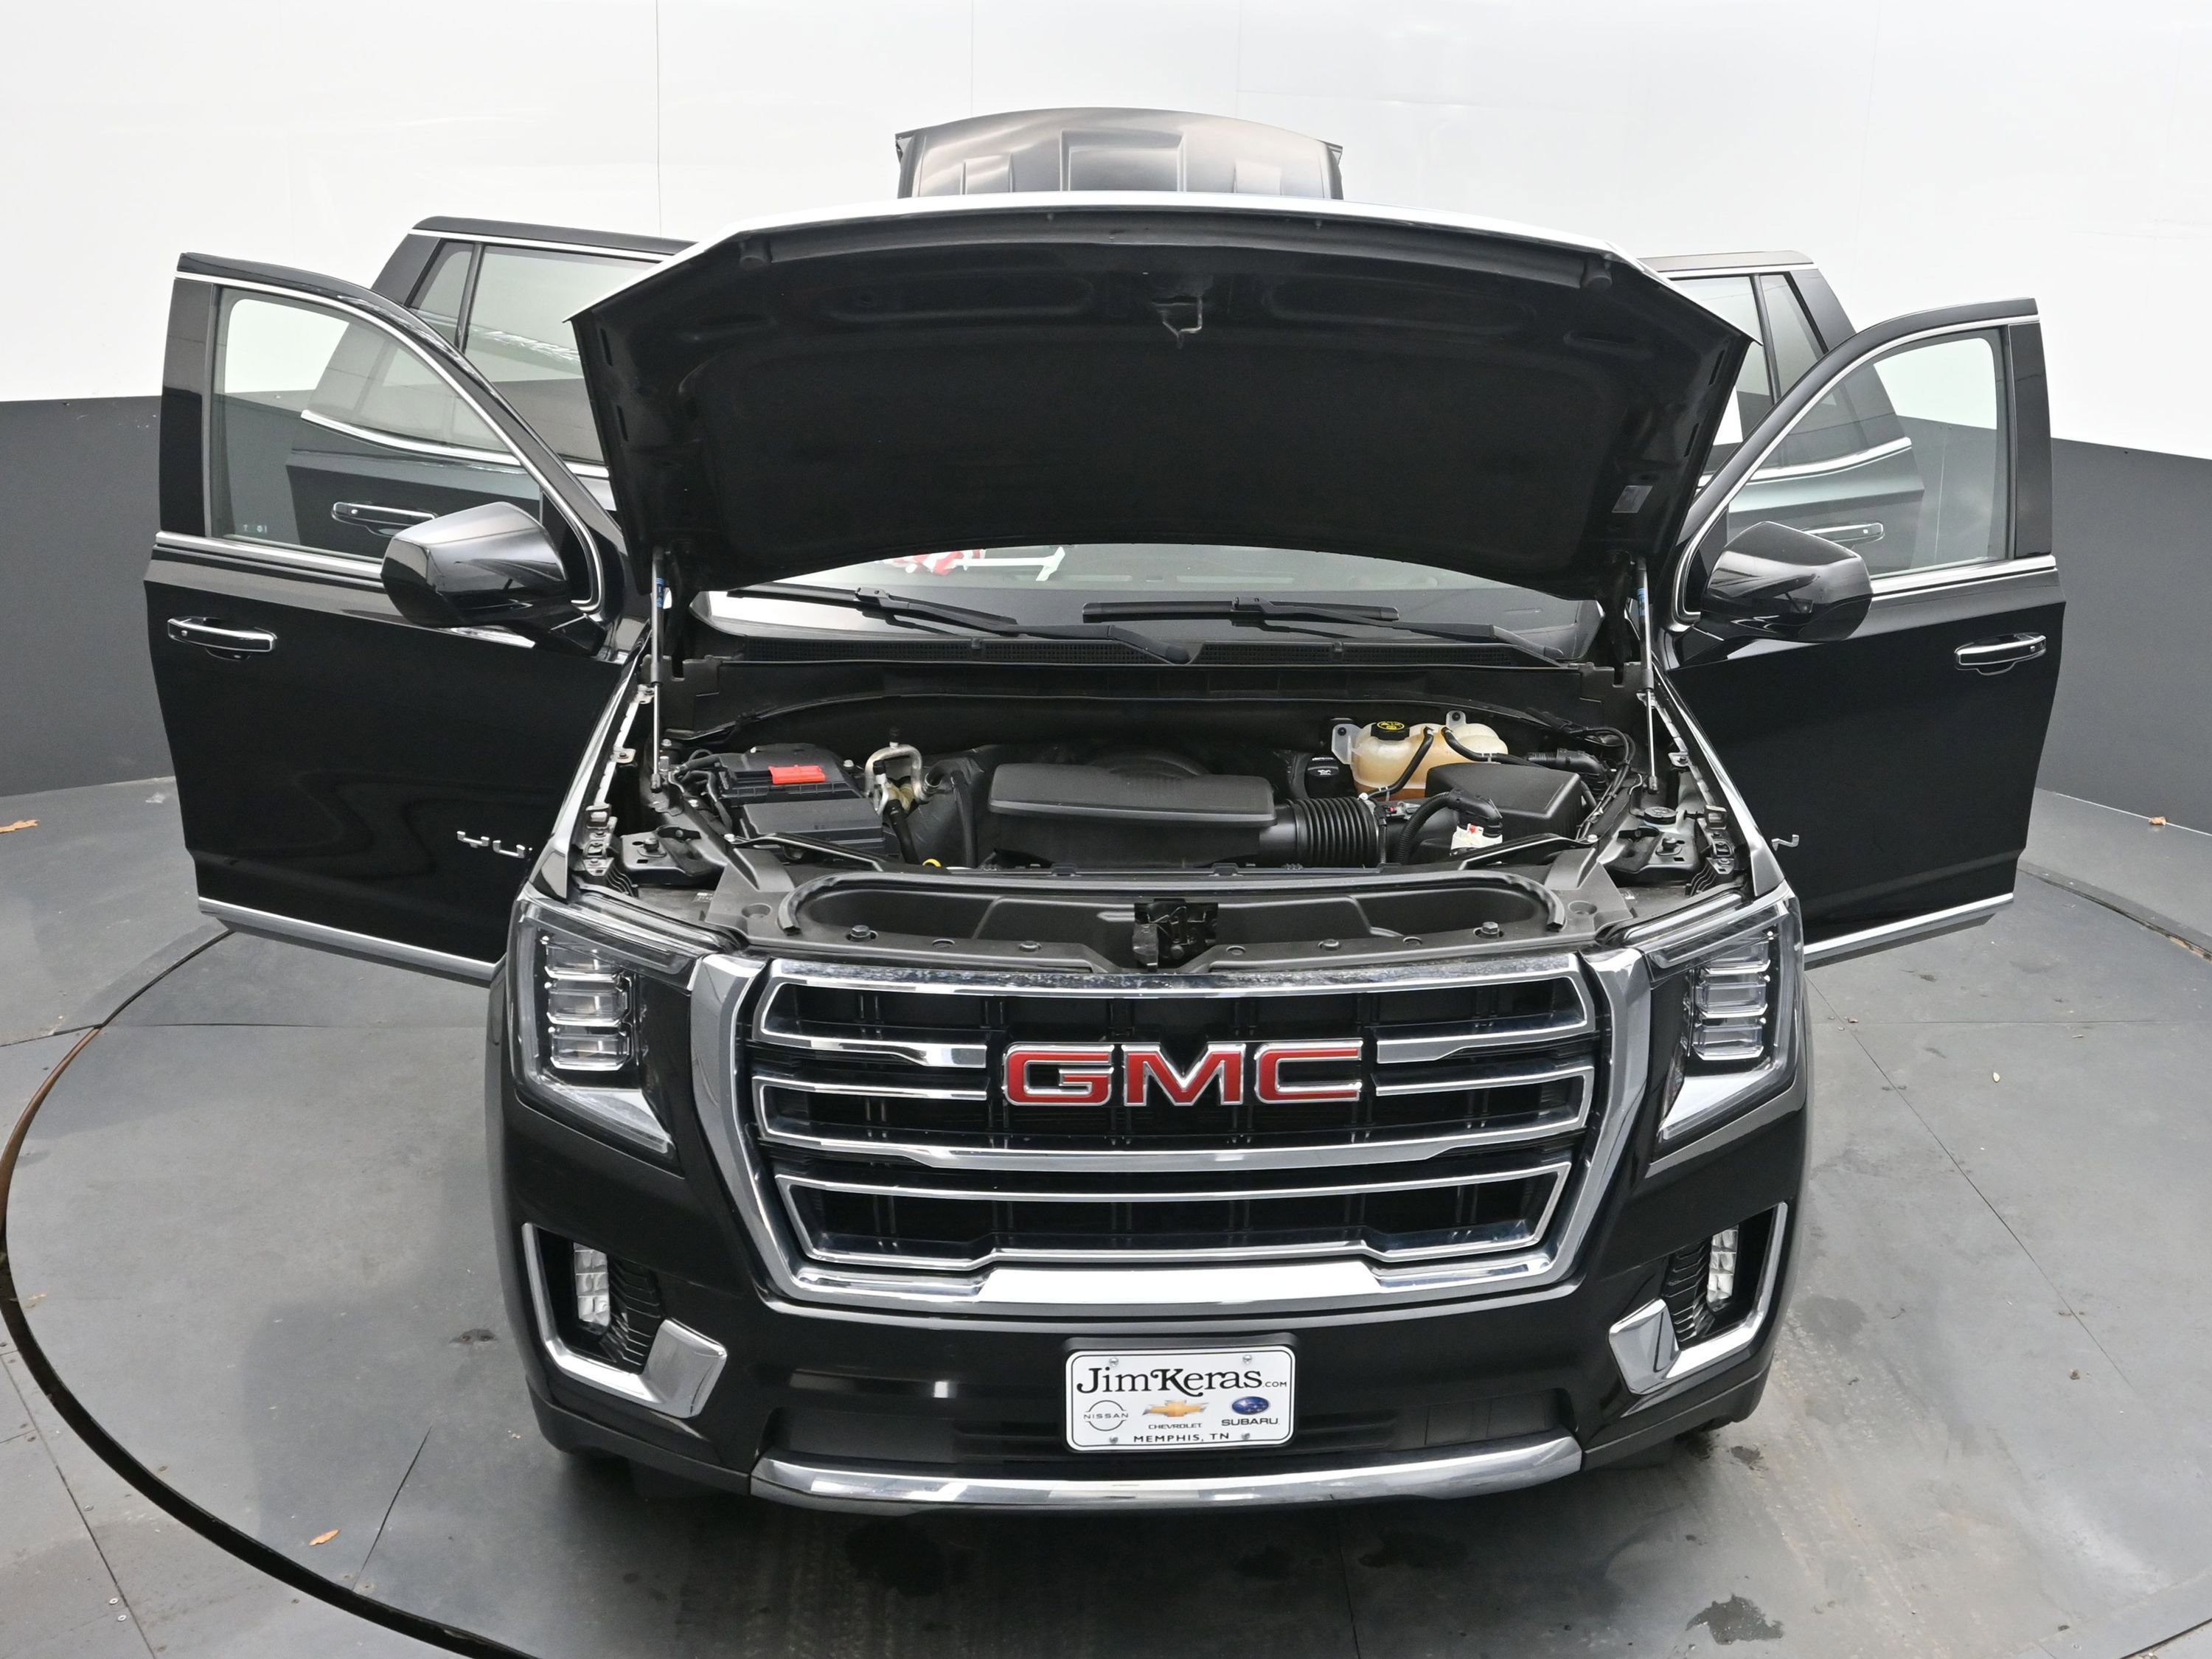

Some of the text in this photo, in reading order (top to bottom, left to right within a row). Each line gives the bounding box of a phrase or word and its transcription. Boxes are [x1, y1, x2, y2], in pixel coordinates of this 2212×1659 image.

[1002, 1039, 1363, 1106] GMC
[1221, 1418, 1279, 1426] SUBARU
[1133, 1434, 1204, 1442] MEMPHIS,
